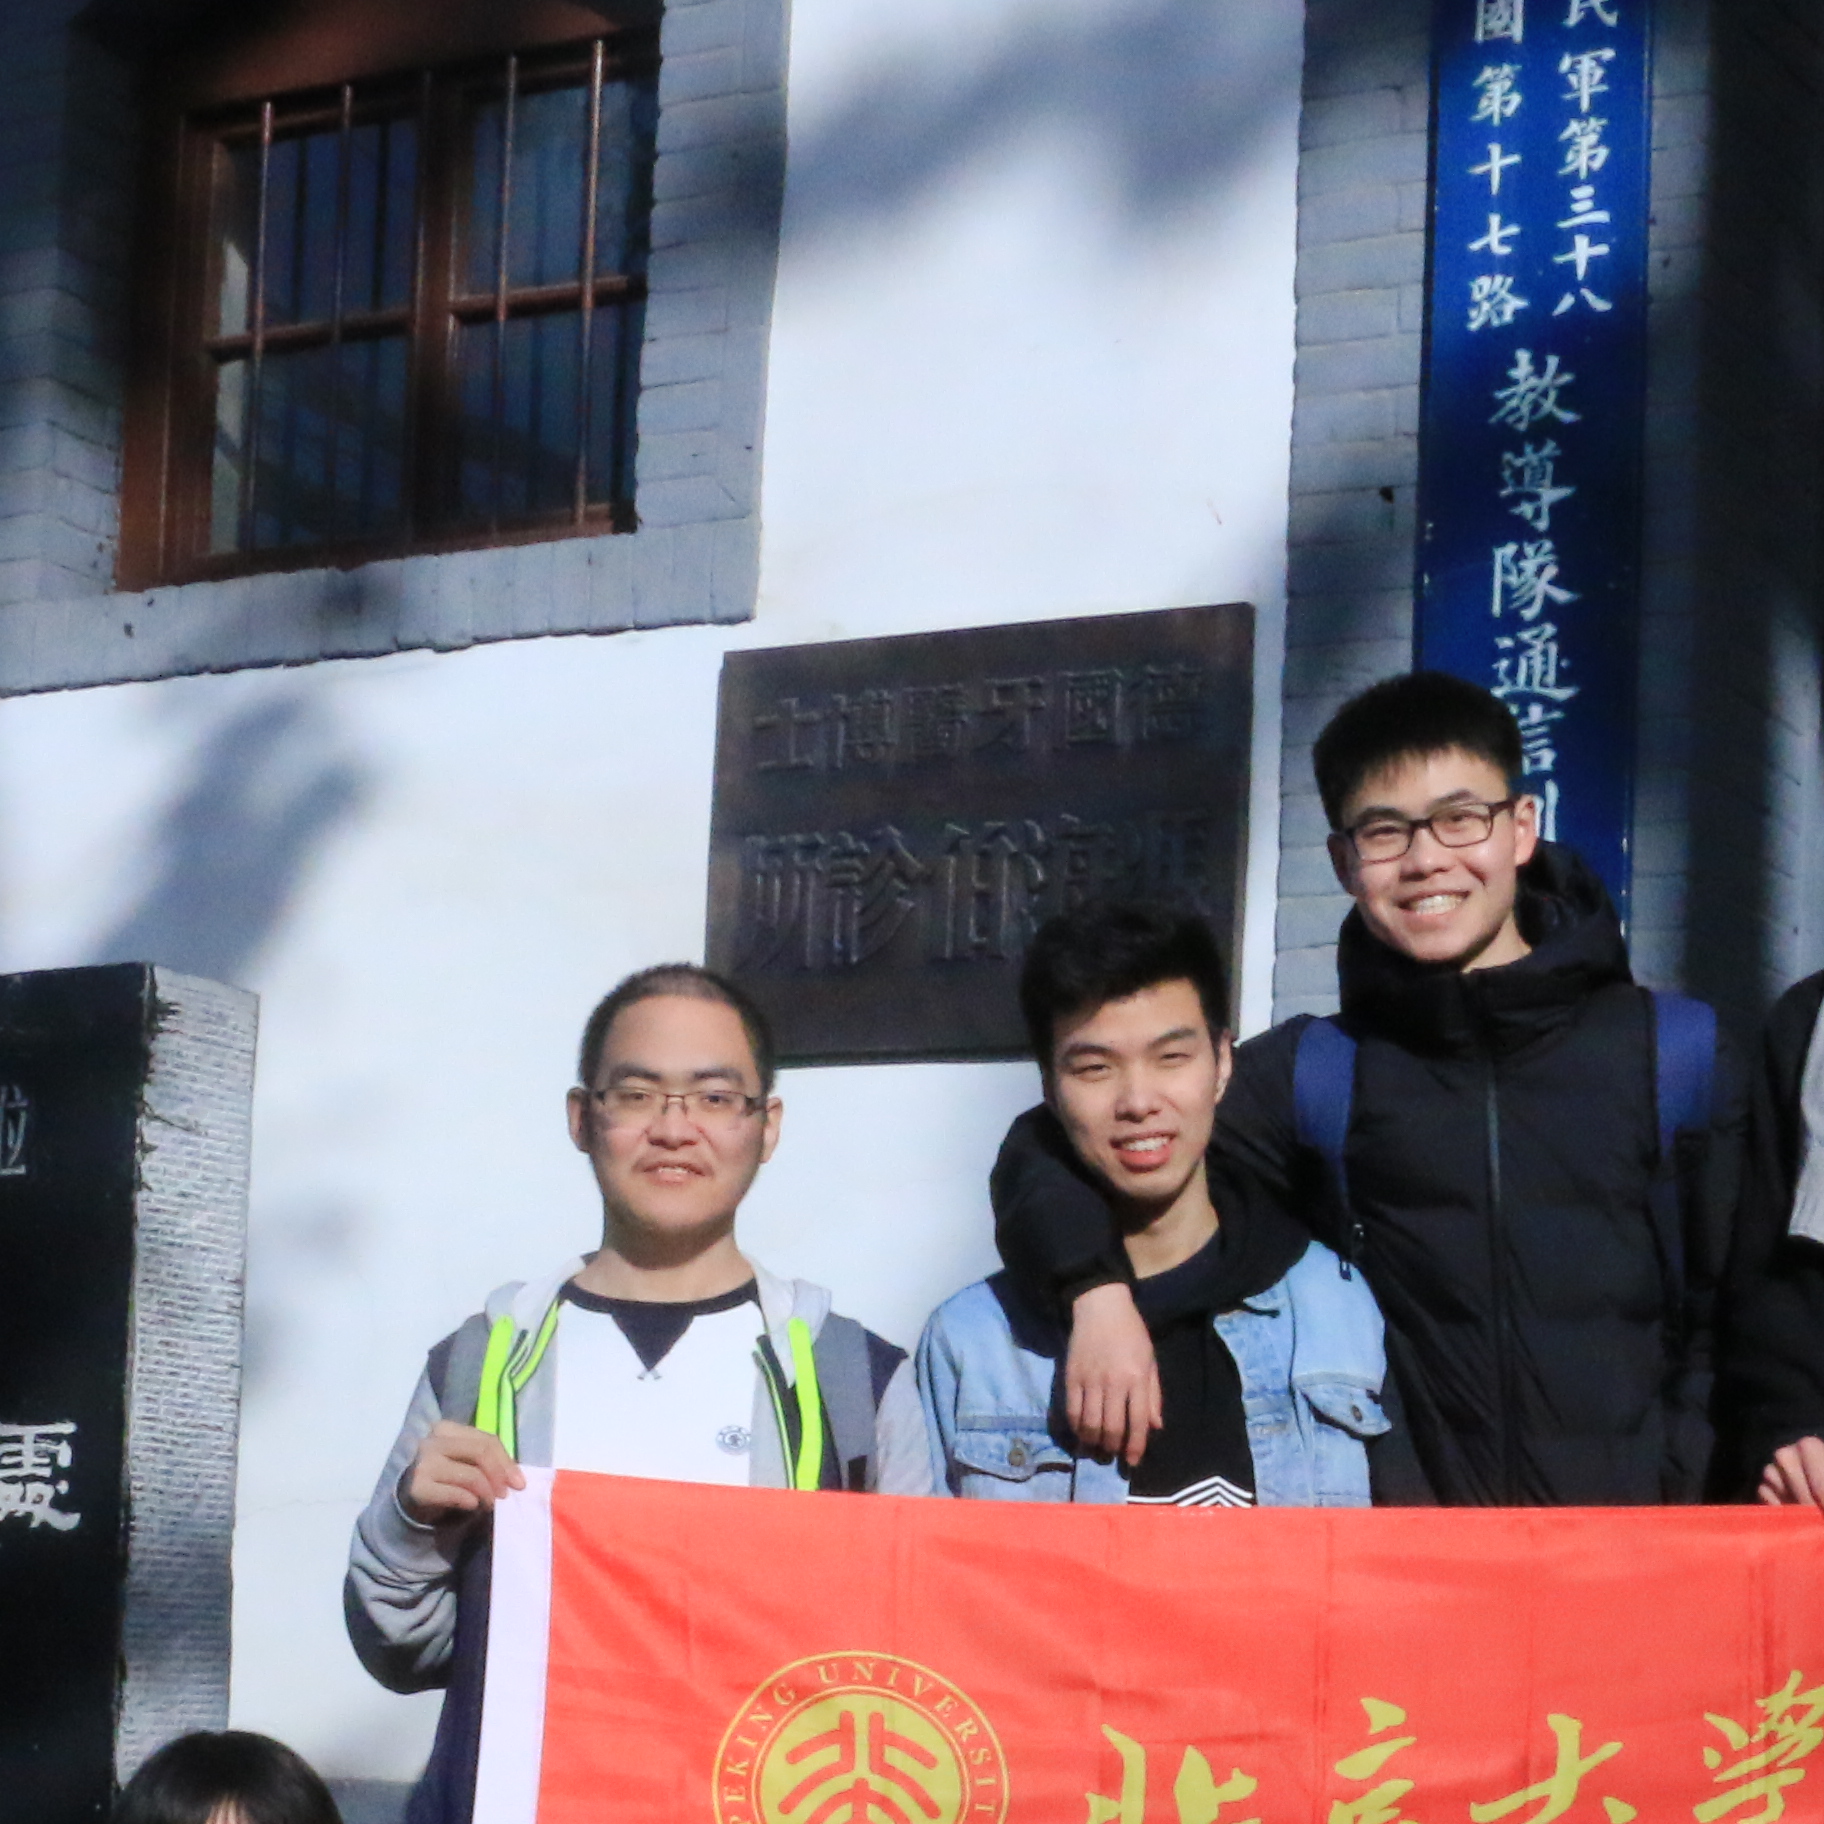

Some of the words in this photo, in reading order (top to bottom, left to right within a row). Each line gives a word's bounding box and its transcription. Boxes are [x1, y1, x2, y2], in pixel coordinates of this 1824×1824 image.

[1488, 347, 1583, 844] 教導隊通信
